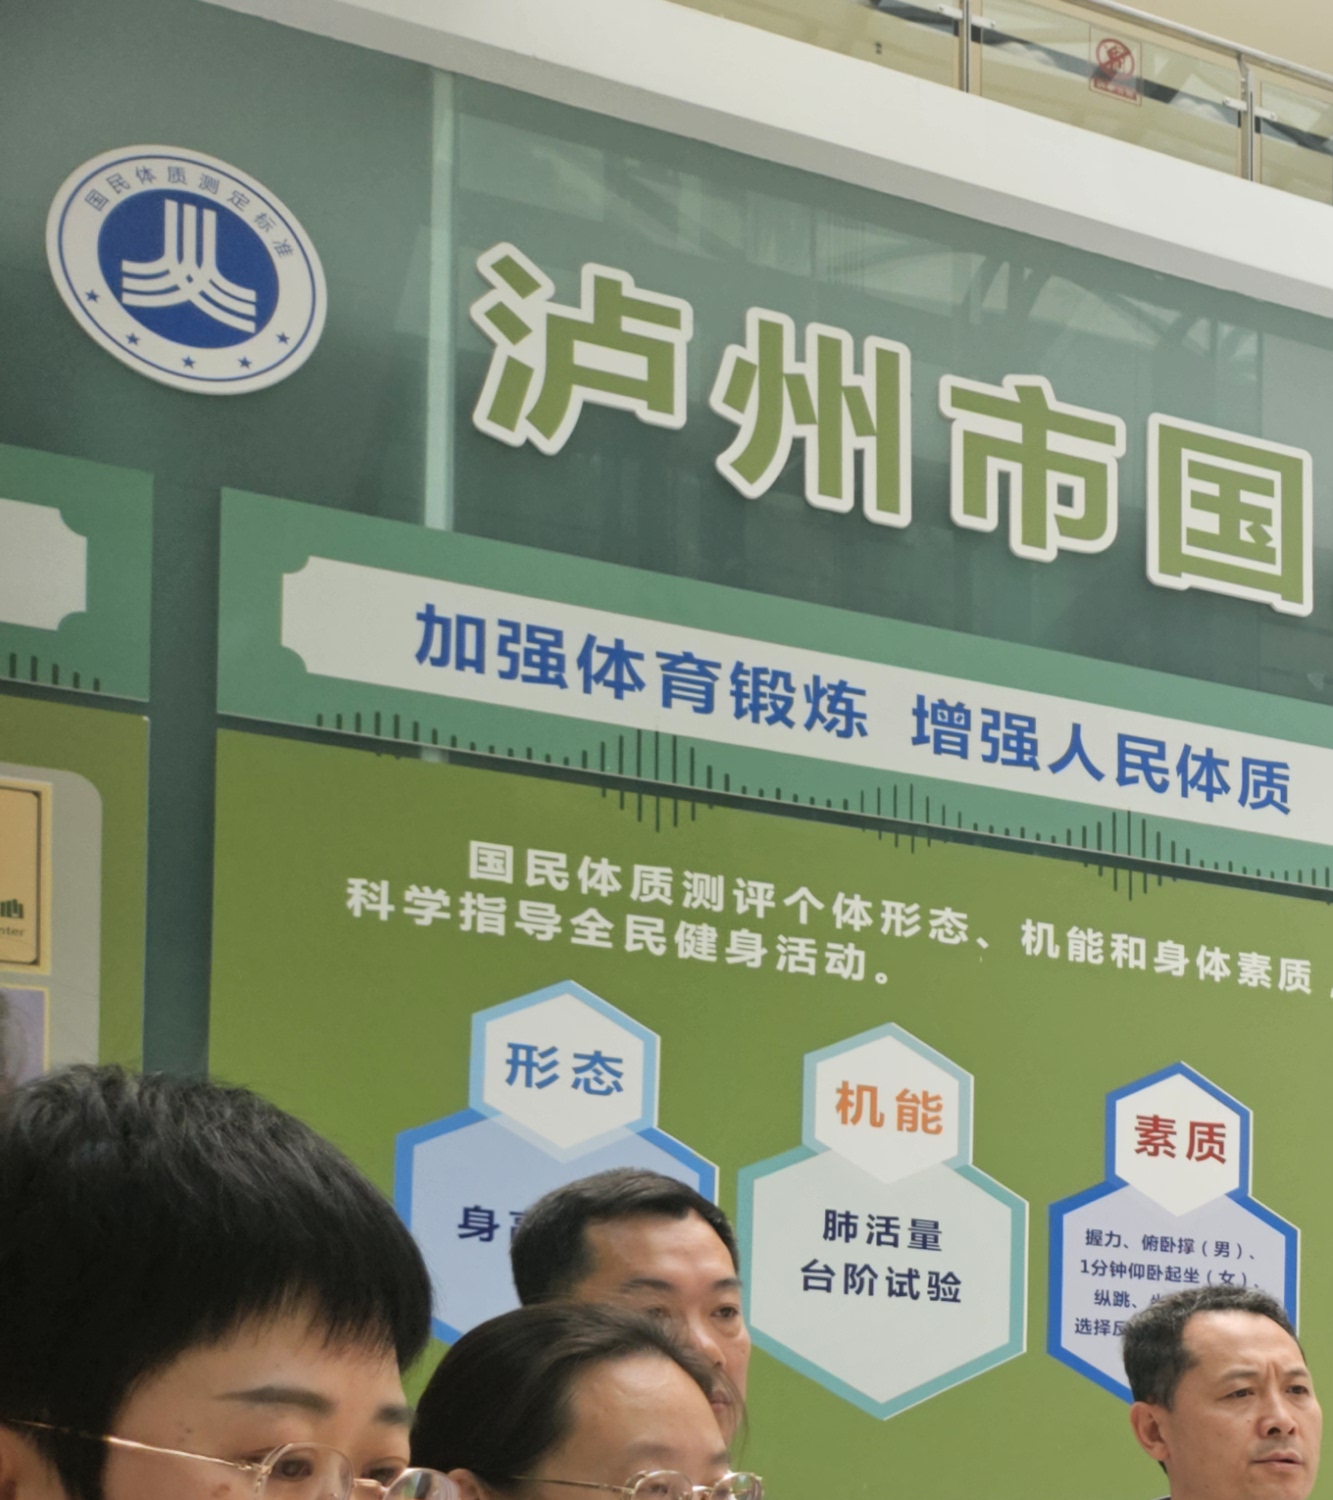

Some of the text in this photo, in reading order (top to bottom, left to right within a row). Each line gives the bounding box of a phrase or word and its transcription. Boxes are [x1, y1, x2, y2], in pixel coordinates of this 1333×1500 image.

[84, 165, 293, 261] 国民体质测定标准
[416, 604, 1292, 816] 加强体育锻炼 增强人民体质
[347, 878, 887, 984] 科学指导全民健身活动。
[505, 1042, 625, 1098] 形态
[836, 1081, 944, 1136] 机能
[1133, 1114, 1228, 1165] 素质
[822, 1209, 943, 1253] 肺活量
[800, 1258, 962, 1304] 台阶试验
